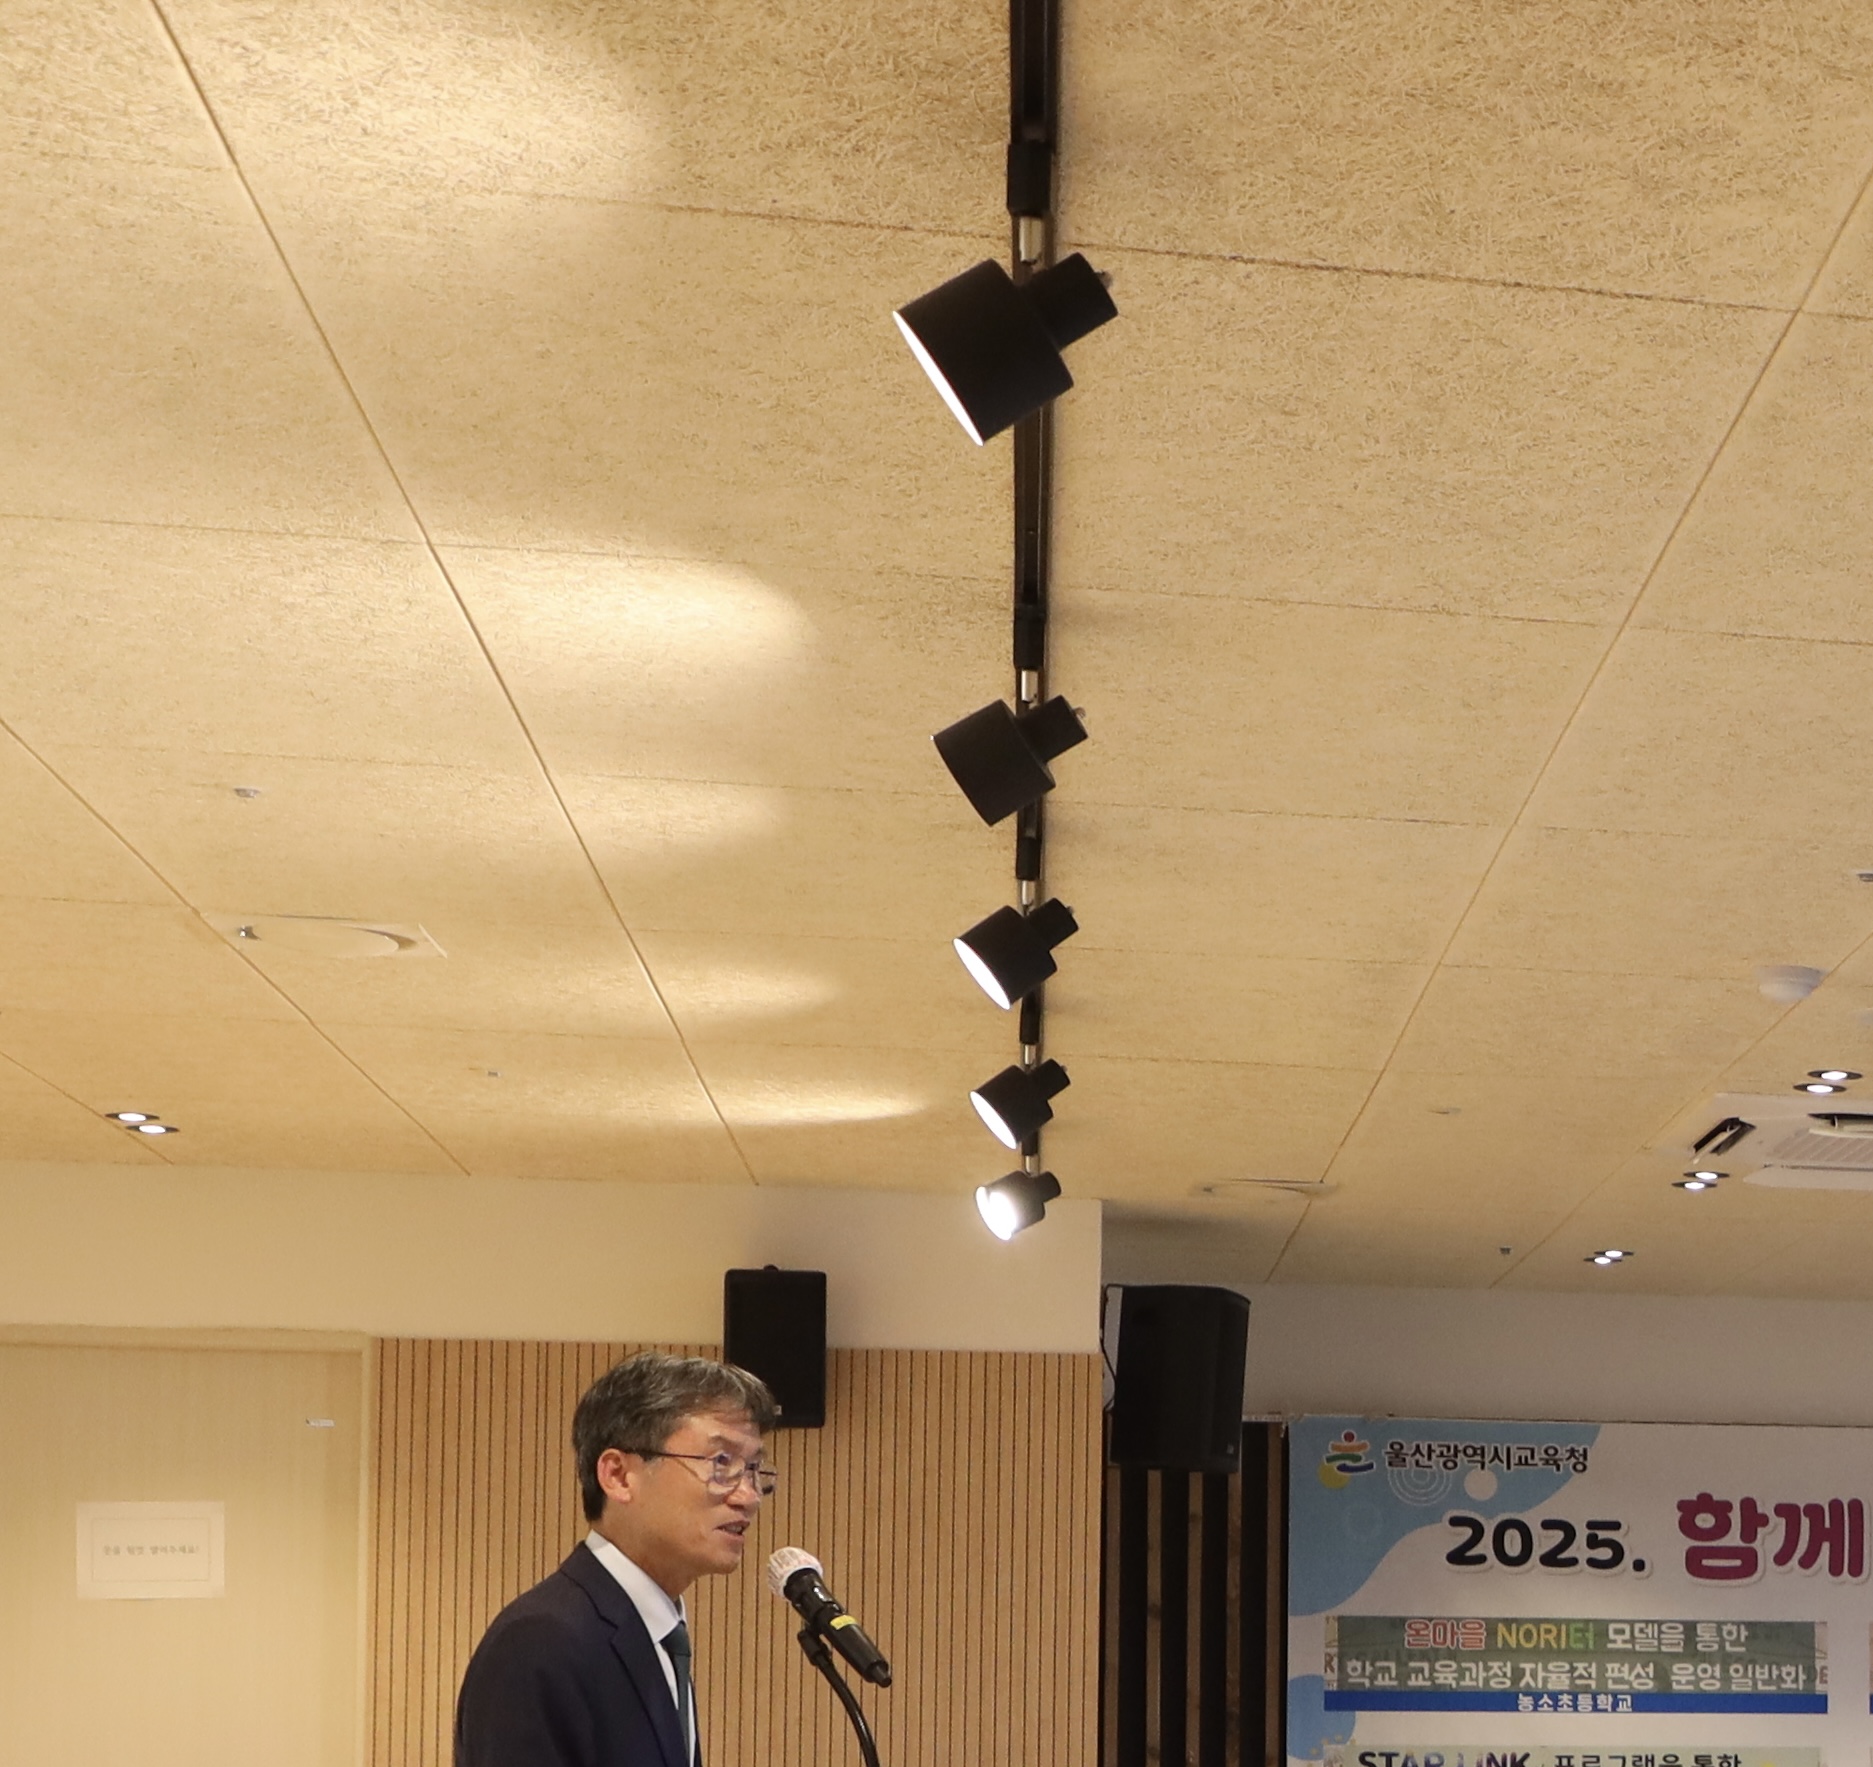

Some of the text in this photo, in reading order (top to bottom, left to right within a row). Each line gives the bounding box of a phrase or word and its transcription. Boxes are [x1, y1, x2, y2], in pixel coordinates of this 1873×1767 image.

[1385, 1441, 1588, 1473] 울산광역시교육청
[1446, 1516, 1646, 1573] 2025.
[1677, 1493, 1864, 1581] 함께
[1404, 1618, 1748, 1653] 온마을 NORI터 모델을 통한
[1346, 1658, 1397, 1688] 학교
[1406, 1660, 1512, 1689] 교육과정
[1519, 1661, 1597, 1690] 자율적
[1605, 1662, 1655, 1690] 편성
[1669, 1662, 1721, 1690] 운영
[1728, 1662, 1806, 1691] 일반화
[1517, 1693, 1632, 1713] 농소초등학교
